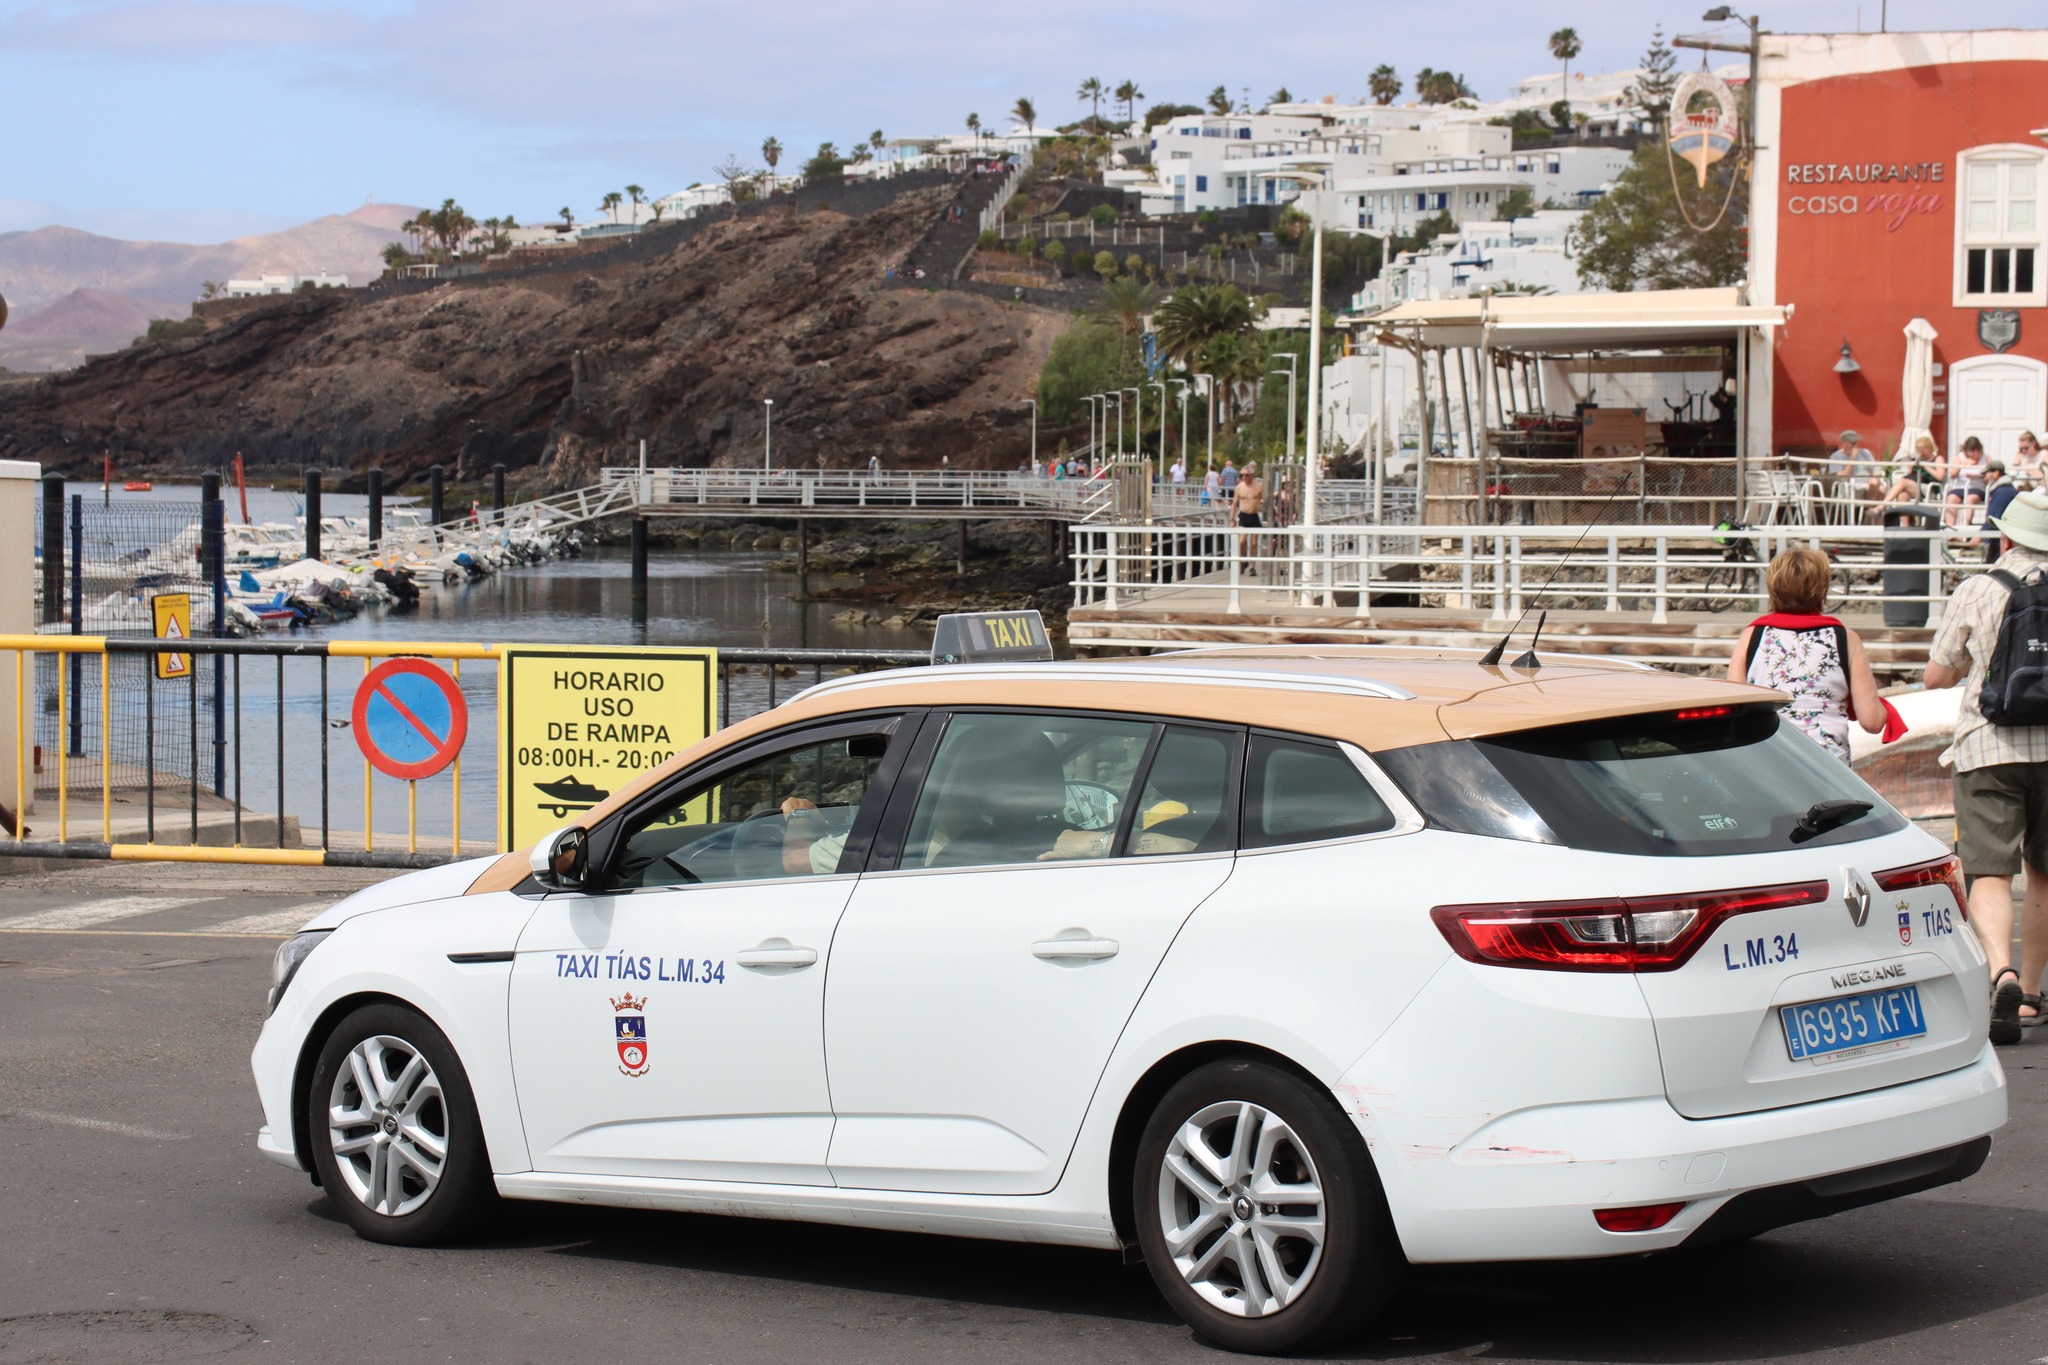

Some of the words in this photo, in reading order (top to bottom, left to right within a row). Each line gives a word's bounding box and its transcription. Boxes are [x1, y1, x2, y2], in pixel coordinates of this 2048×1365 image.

[1788, 162, 1944, 184] RESTAURANTE
[1788, 195, 1858, 215] casa
[1864, 184, 1943, 233] roja
[984, 617, 1033, 649] TAXI
[554, 671, 665, 692] HORARIO
[584, 697, 634, 717] USO
[548, 722, 578, 742] DE
[587, 723, 671, 744] RAMPA
[1922, 903, 1953, 937] TÍAS
[556, 954, 599, 979] TAXI
[605, 949, 651, 981] TÍAS
[658, 957, 725, 985] L.M.34
[1723, 932, 1799, 971] L.M.34
[1830, 964, 1907, 989] MEGANE
[1791, 1038, 1800, 1050] E
[1801, 1000, 1869, 1048] 6935
[1872, 989, 1919, 1035] KFV
